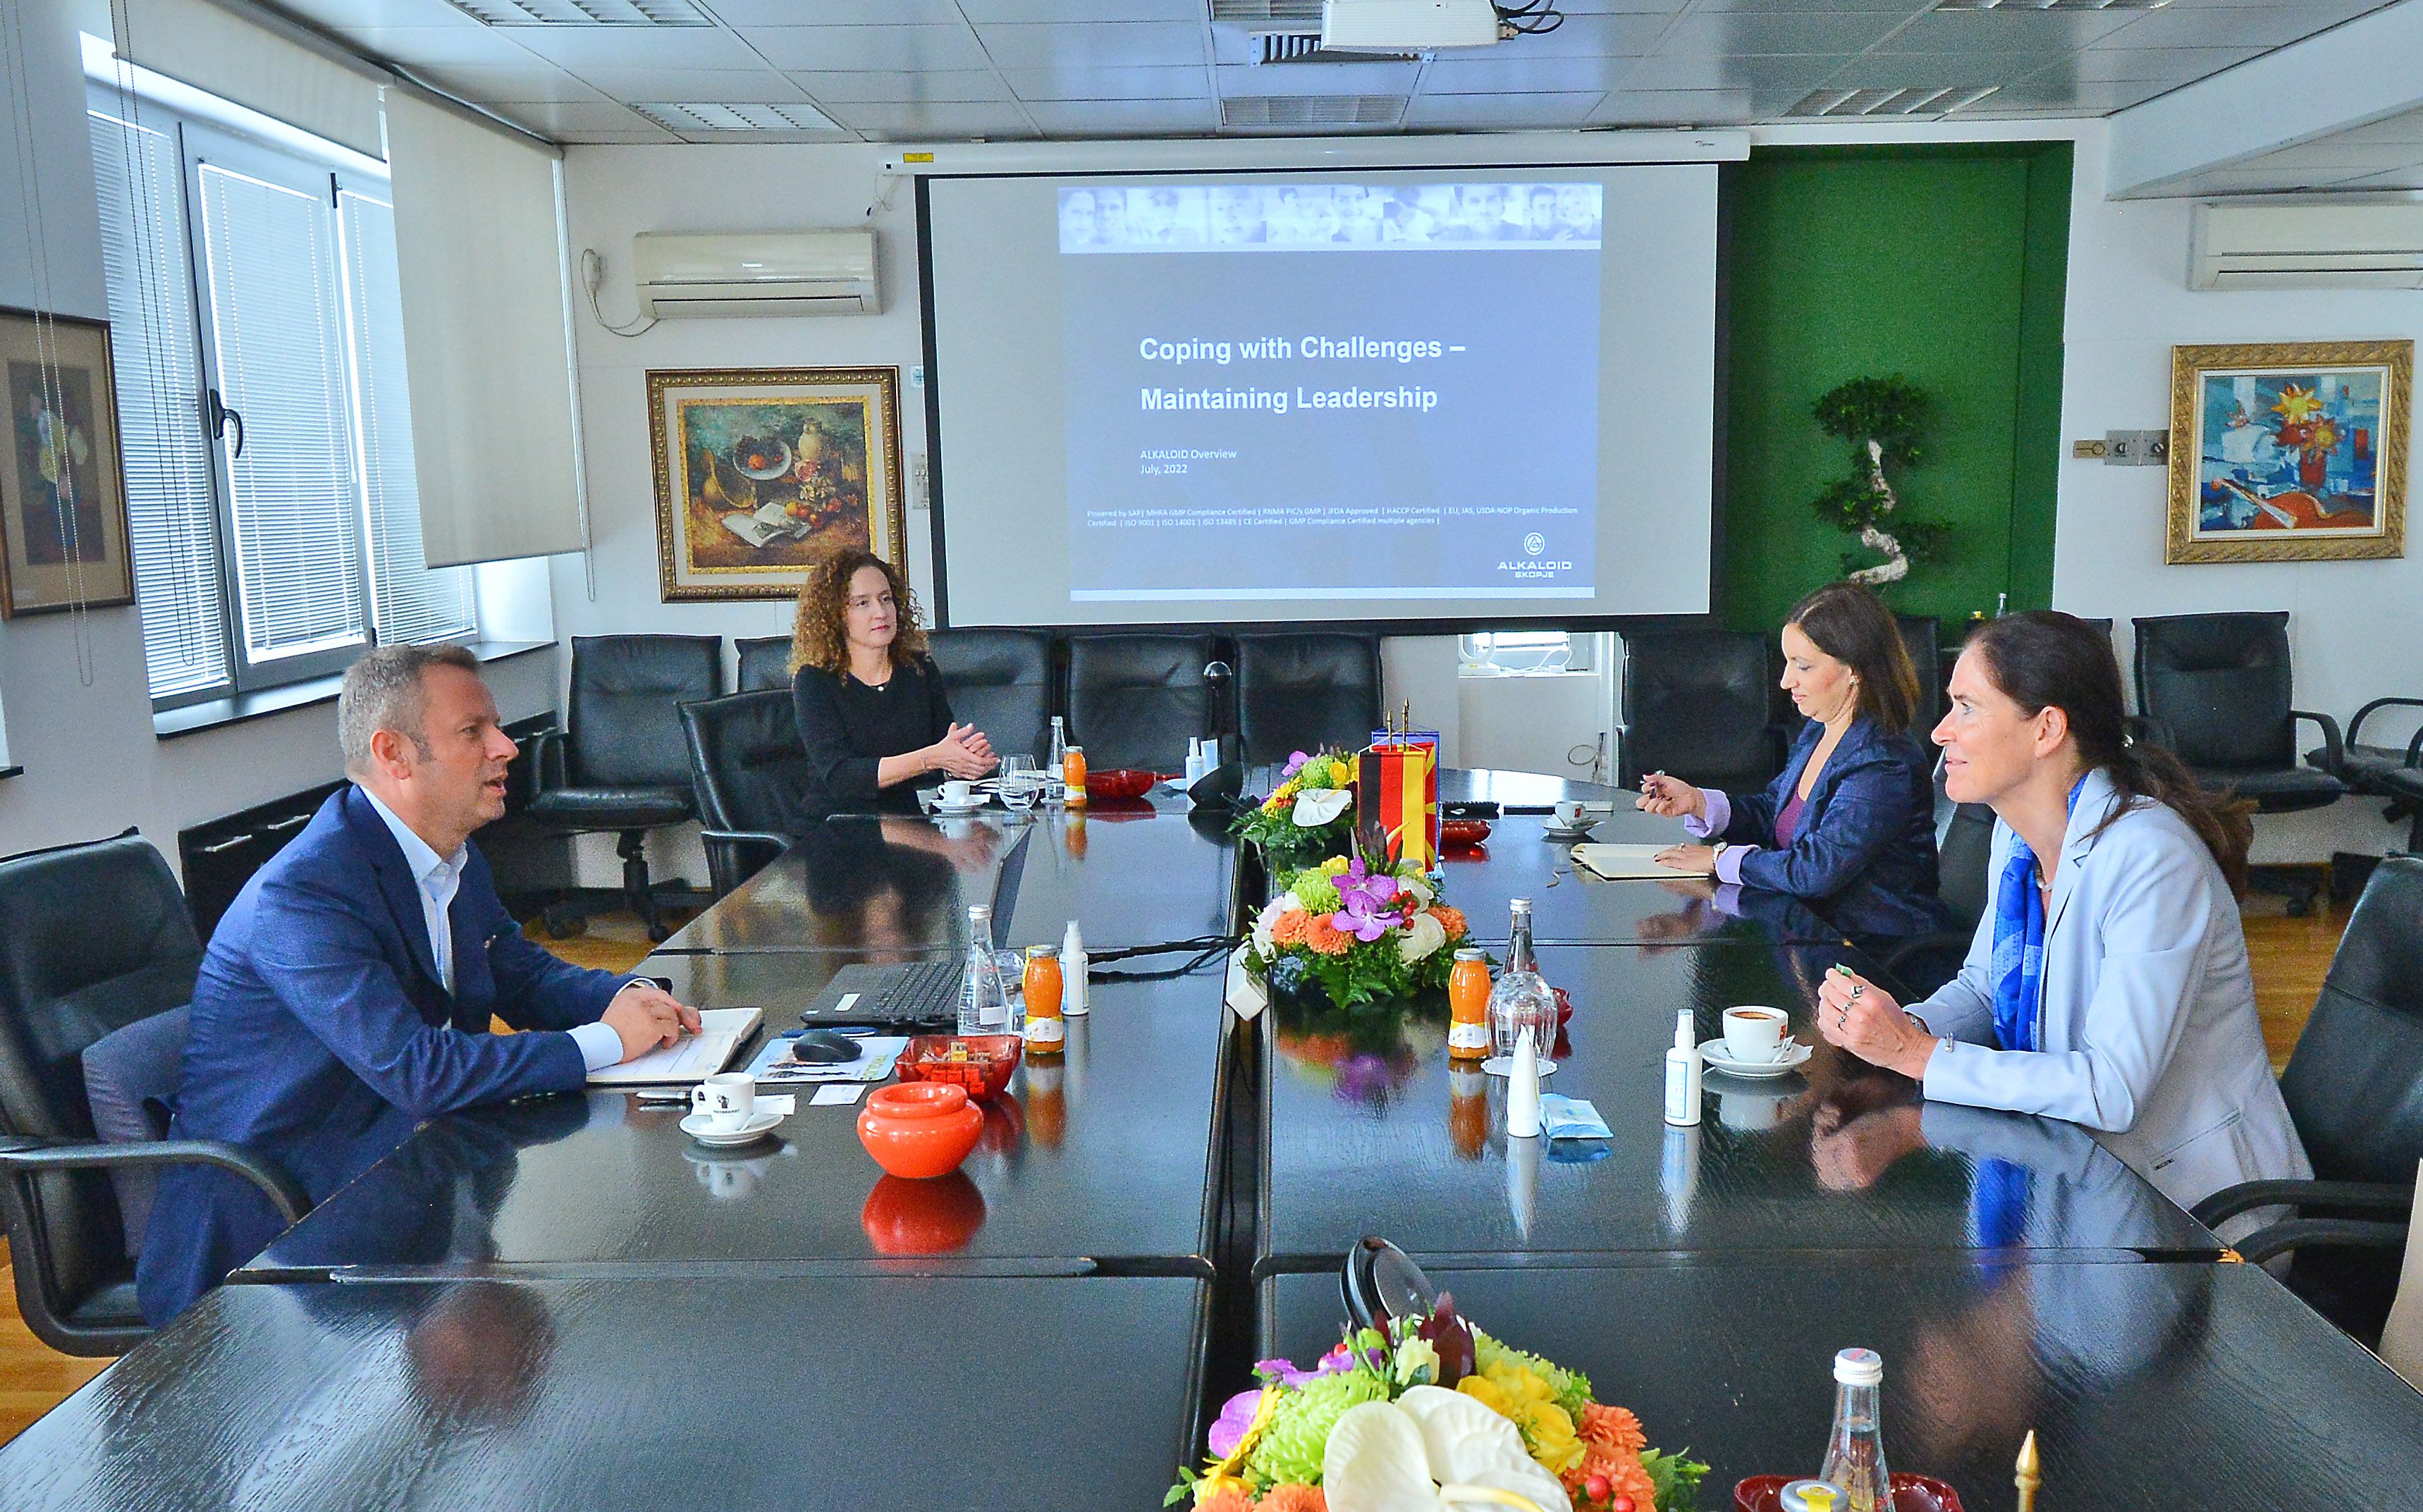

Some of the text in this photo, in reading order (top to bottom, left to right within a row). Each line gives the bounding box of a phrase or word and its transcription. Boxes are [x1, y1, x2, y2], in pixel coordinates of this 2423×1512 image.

[1139, 337, 1231, 365] Coping
[1239, 337, 1292, 359] with
[1300, 336, 1442, 364] Challenges
[1141, 386, 1438, 414] Maintaining Leadership
[1140, 448, 1237, 460] ALKALOID Overview
[1140, 464, 1188, 476] July, 2022
[1119, 510, 1127, 518] by
[1186, 508, 1226, 517] Compliance
[1304, 507, 1321, 515] GMP
[1345, 507, 1378, 516] Approved
[1411, 506, 1440, 515] Certified
[1449, 507, 1460, 515] EU,
[1461, 507, 1475, 515] JAS,
[1514, 507, 1540, 515] Organic
[1306, 517, 1346, 526] Compliance
[1347, 517, 1376, 525] Certified
[1378, 517, 1405, 525] multiple
[1406, 517, 1435, 526] agencies
[1497, 561, 1572, 570] ALKALOID
